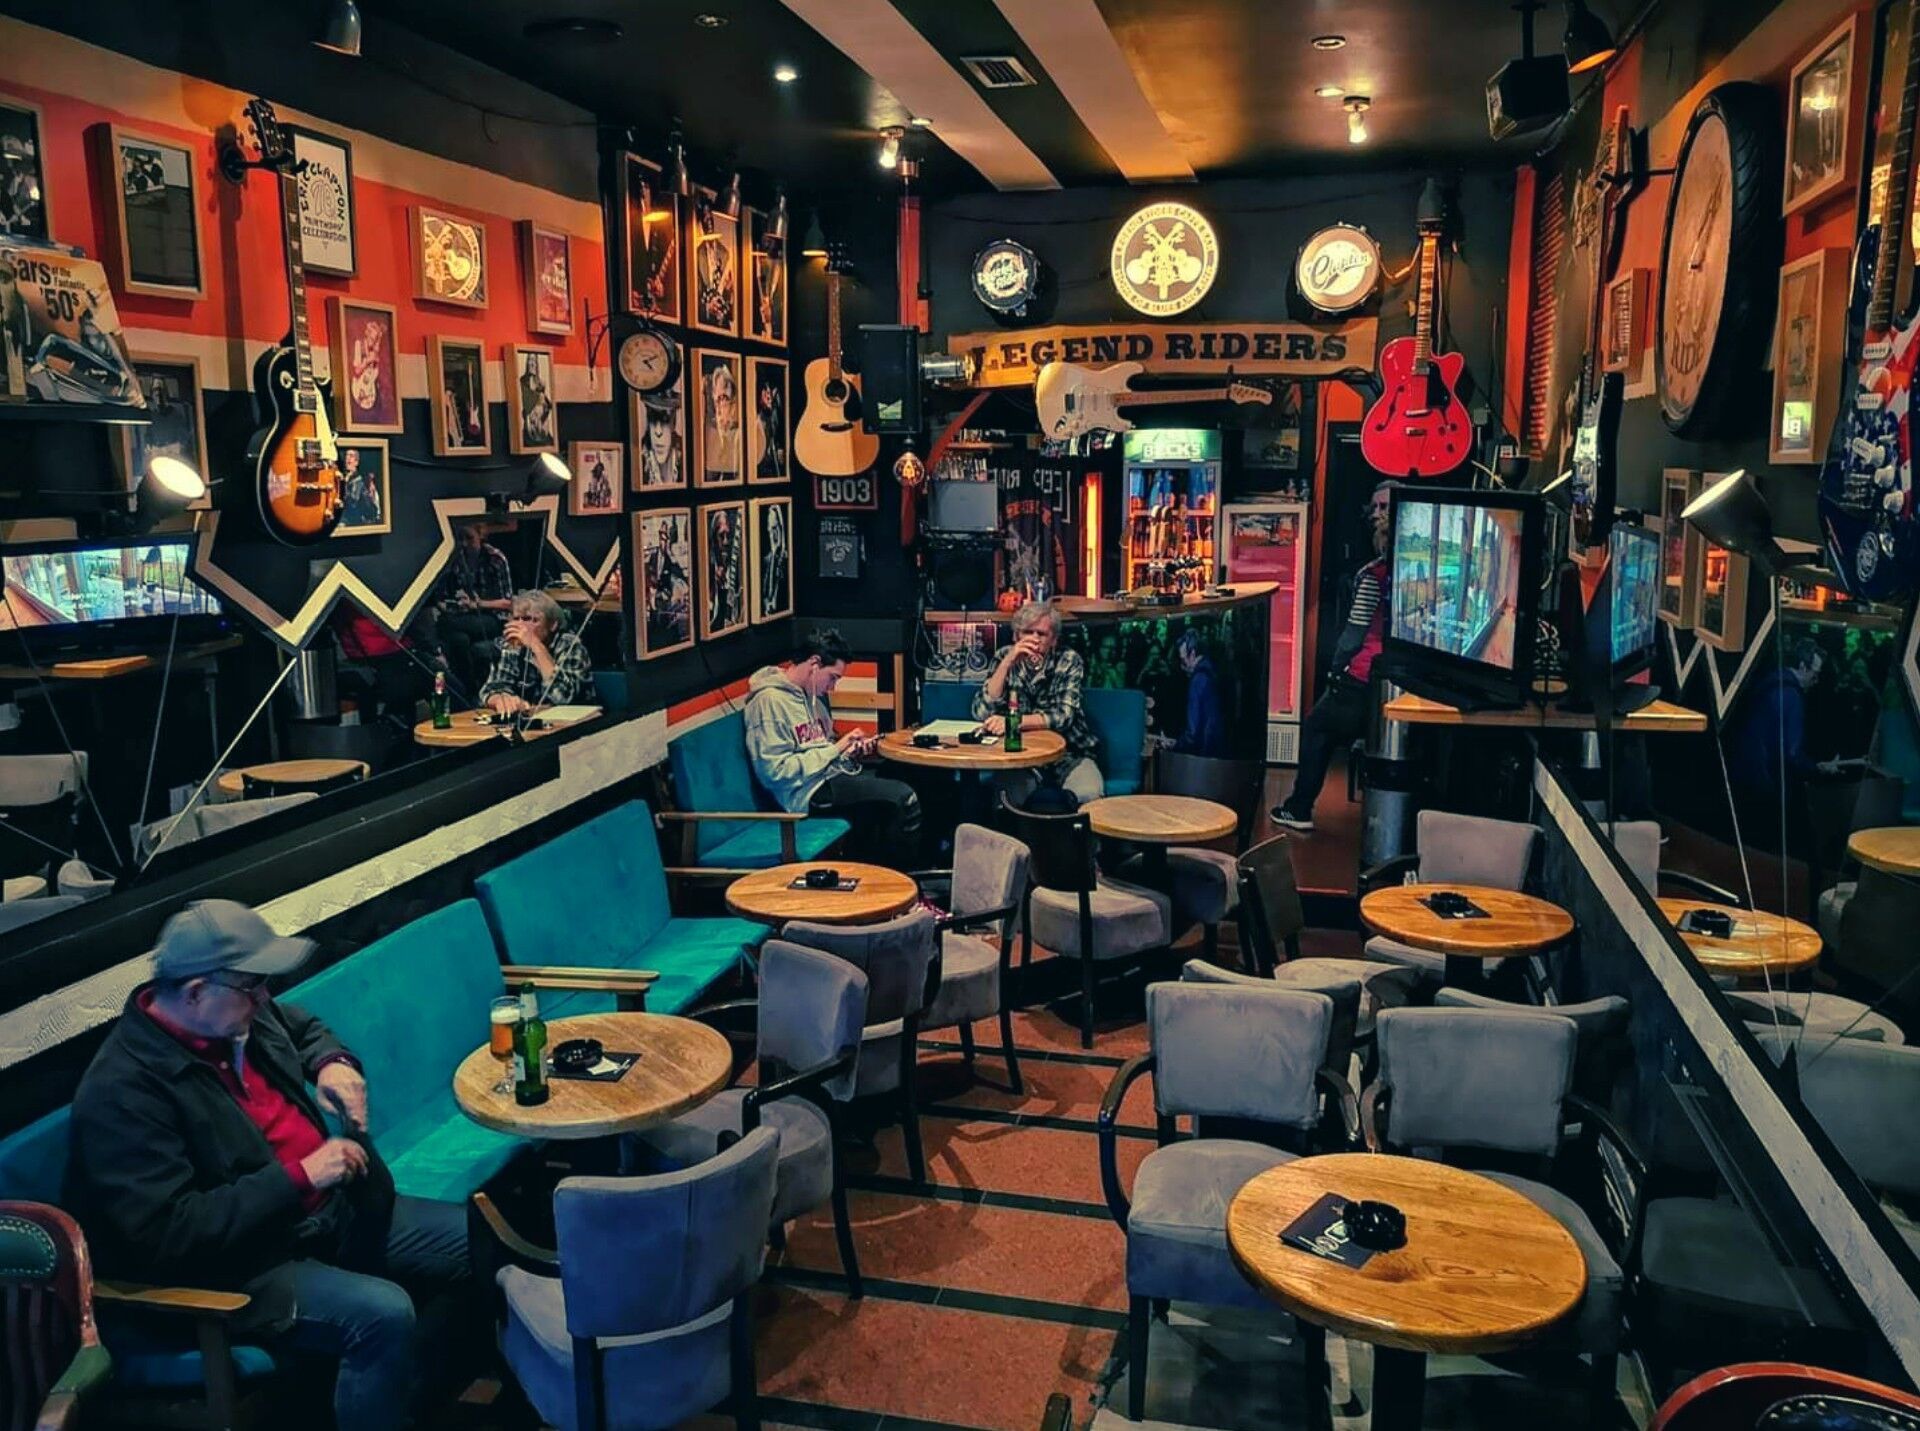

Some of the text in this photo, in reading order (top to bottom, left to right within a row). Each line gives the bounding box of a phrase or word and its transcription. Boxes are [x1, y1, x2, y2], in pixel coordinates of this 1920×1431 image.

[972, 332, 1348, 370] LEGEND RIDERS
[821, 479, 871, 503] 1903
